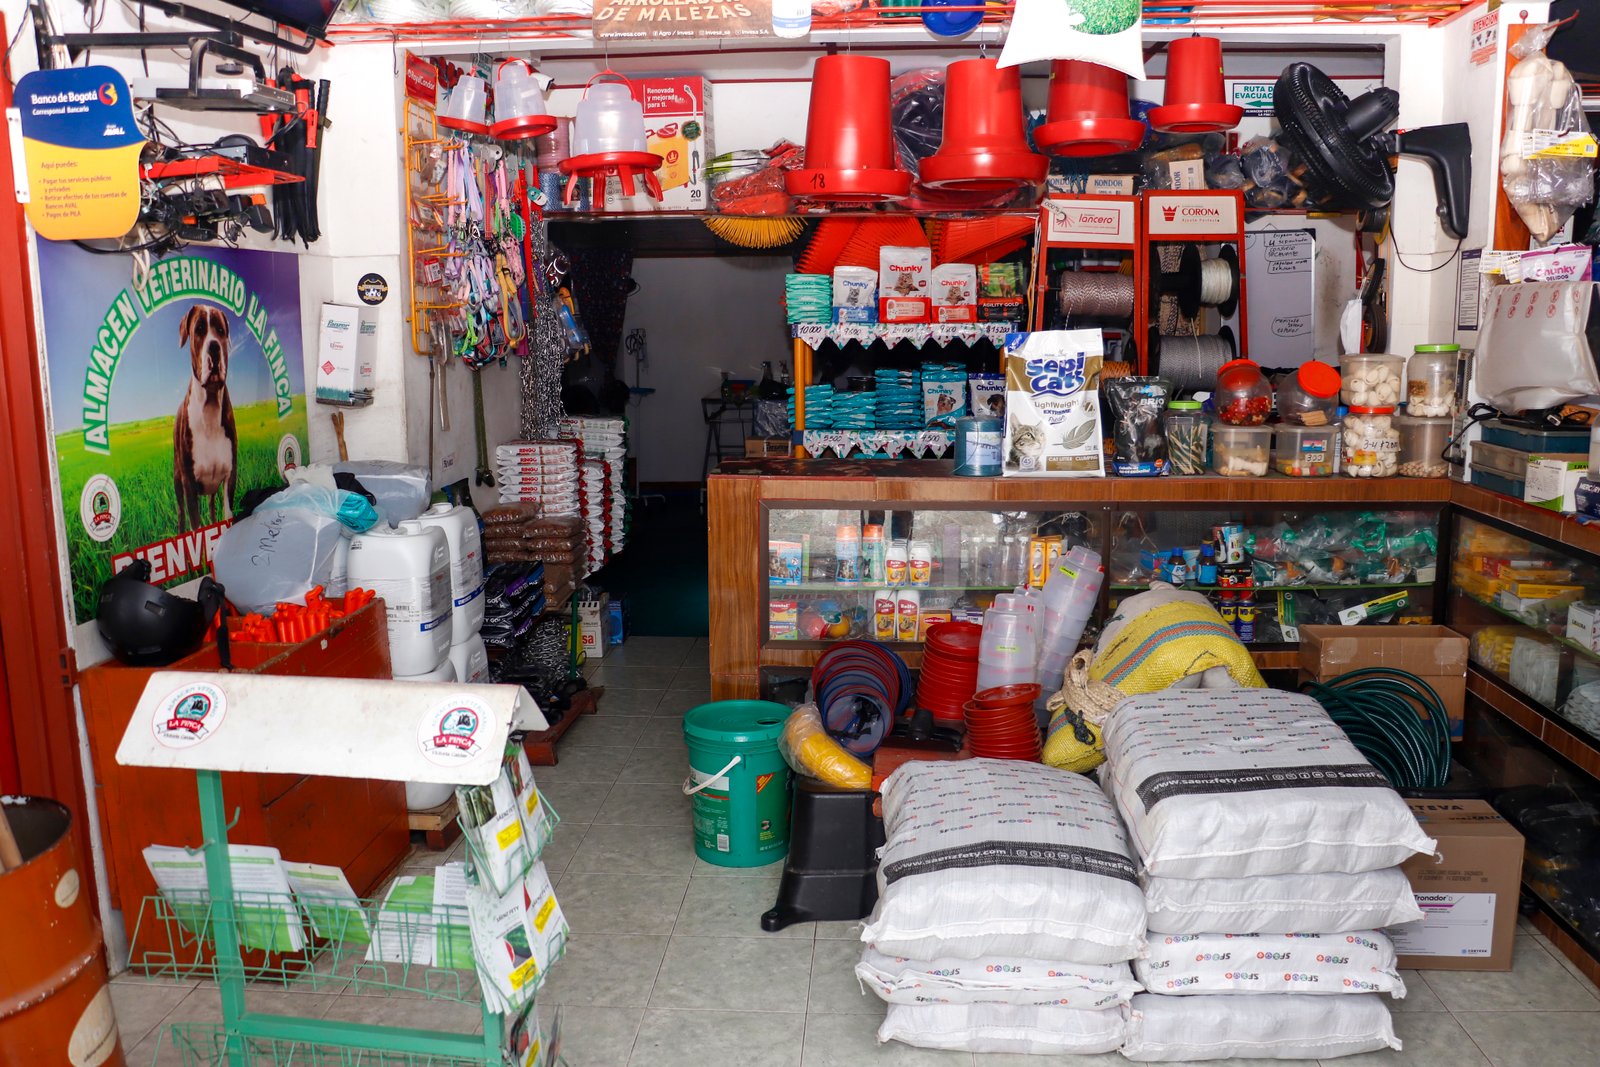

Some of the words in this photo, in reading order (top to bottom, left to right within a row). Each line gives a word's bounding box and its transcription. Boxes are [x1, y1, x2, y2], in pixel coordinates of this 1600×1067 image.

[595, 7, 630, 21] DE
[637, 3, 752, 22] MALEZAS
[31, 93, 57, 104] Banco
[58, 92, 68, 102] de
[68, 90, 98, 104] Bogotá
[32, 106, 66, 116] Corresponsal
[66, 106, 90, 114] Bancario
[811, 173, 826, 188] 18
[690, 190, 701, 198] 20
[1079, 214, 1113, 224] lancero
[889, 264, 922, 274] Chunky
[1536, 266, 1576, 277] Chunky
[135, 258, 246, 311] VETERINARIO
[843, 280, 868, 289] Chunky
[247, 294, 266, 336] LA
[84, 292, 139, 446] ALMACEN
[264, 330, 293, 413] FINCA
[180, 720, 202, 730] FINCA
[448, 737, 472, 746] FINCA
[1150, 774, 1264, 793] www.saenzfety.com
[893, 848, 1007, 872] www.saenzfety.com
